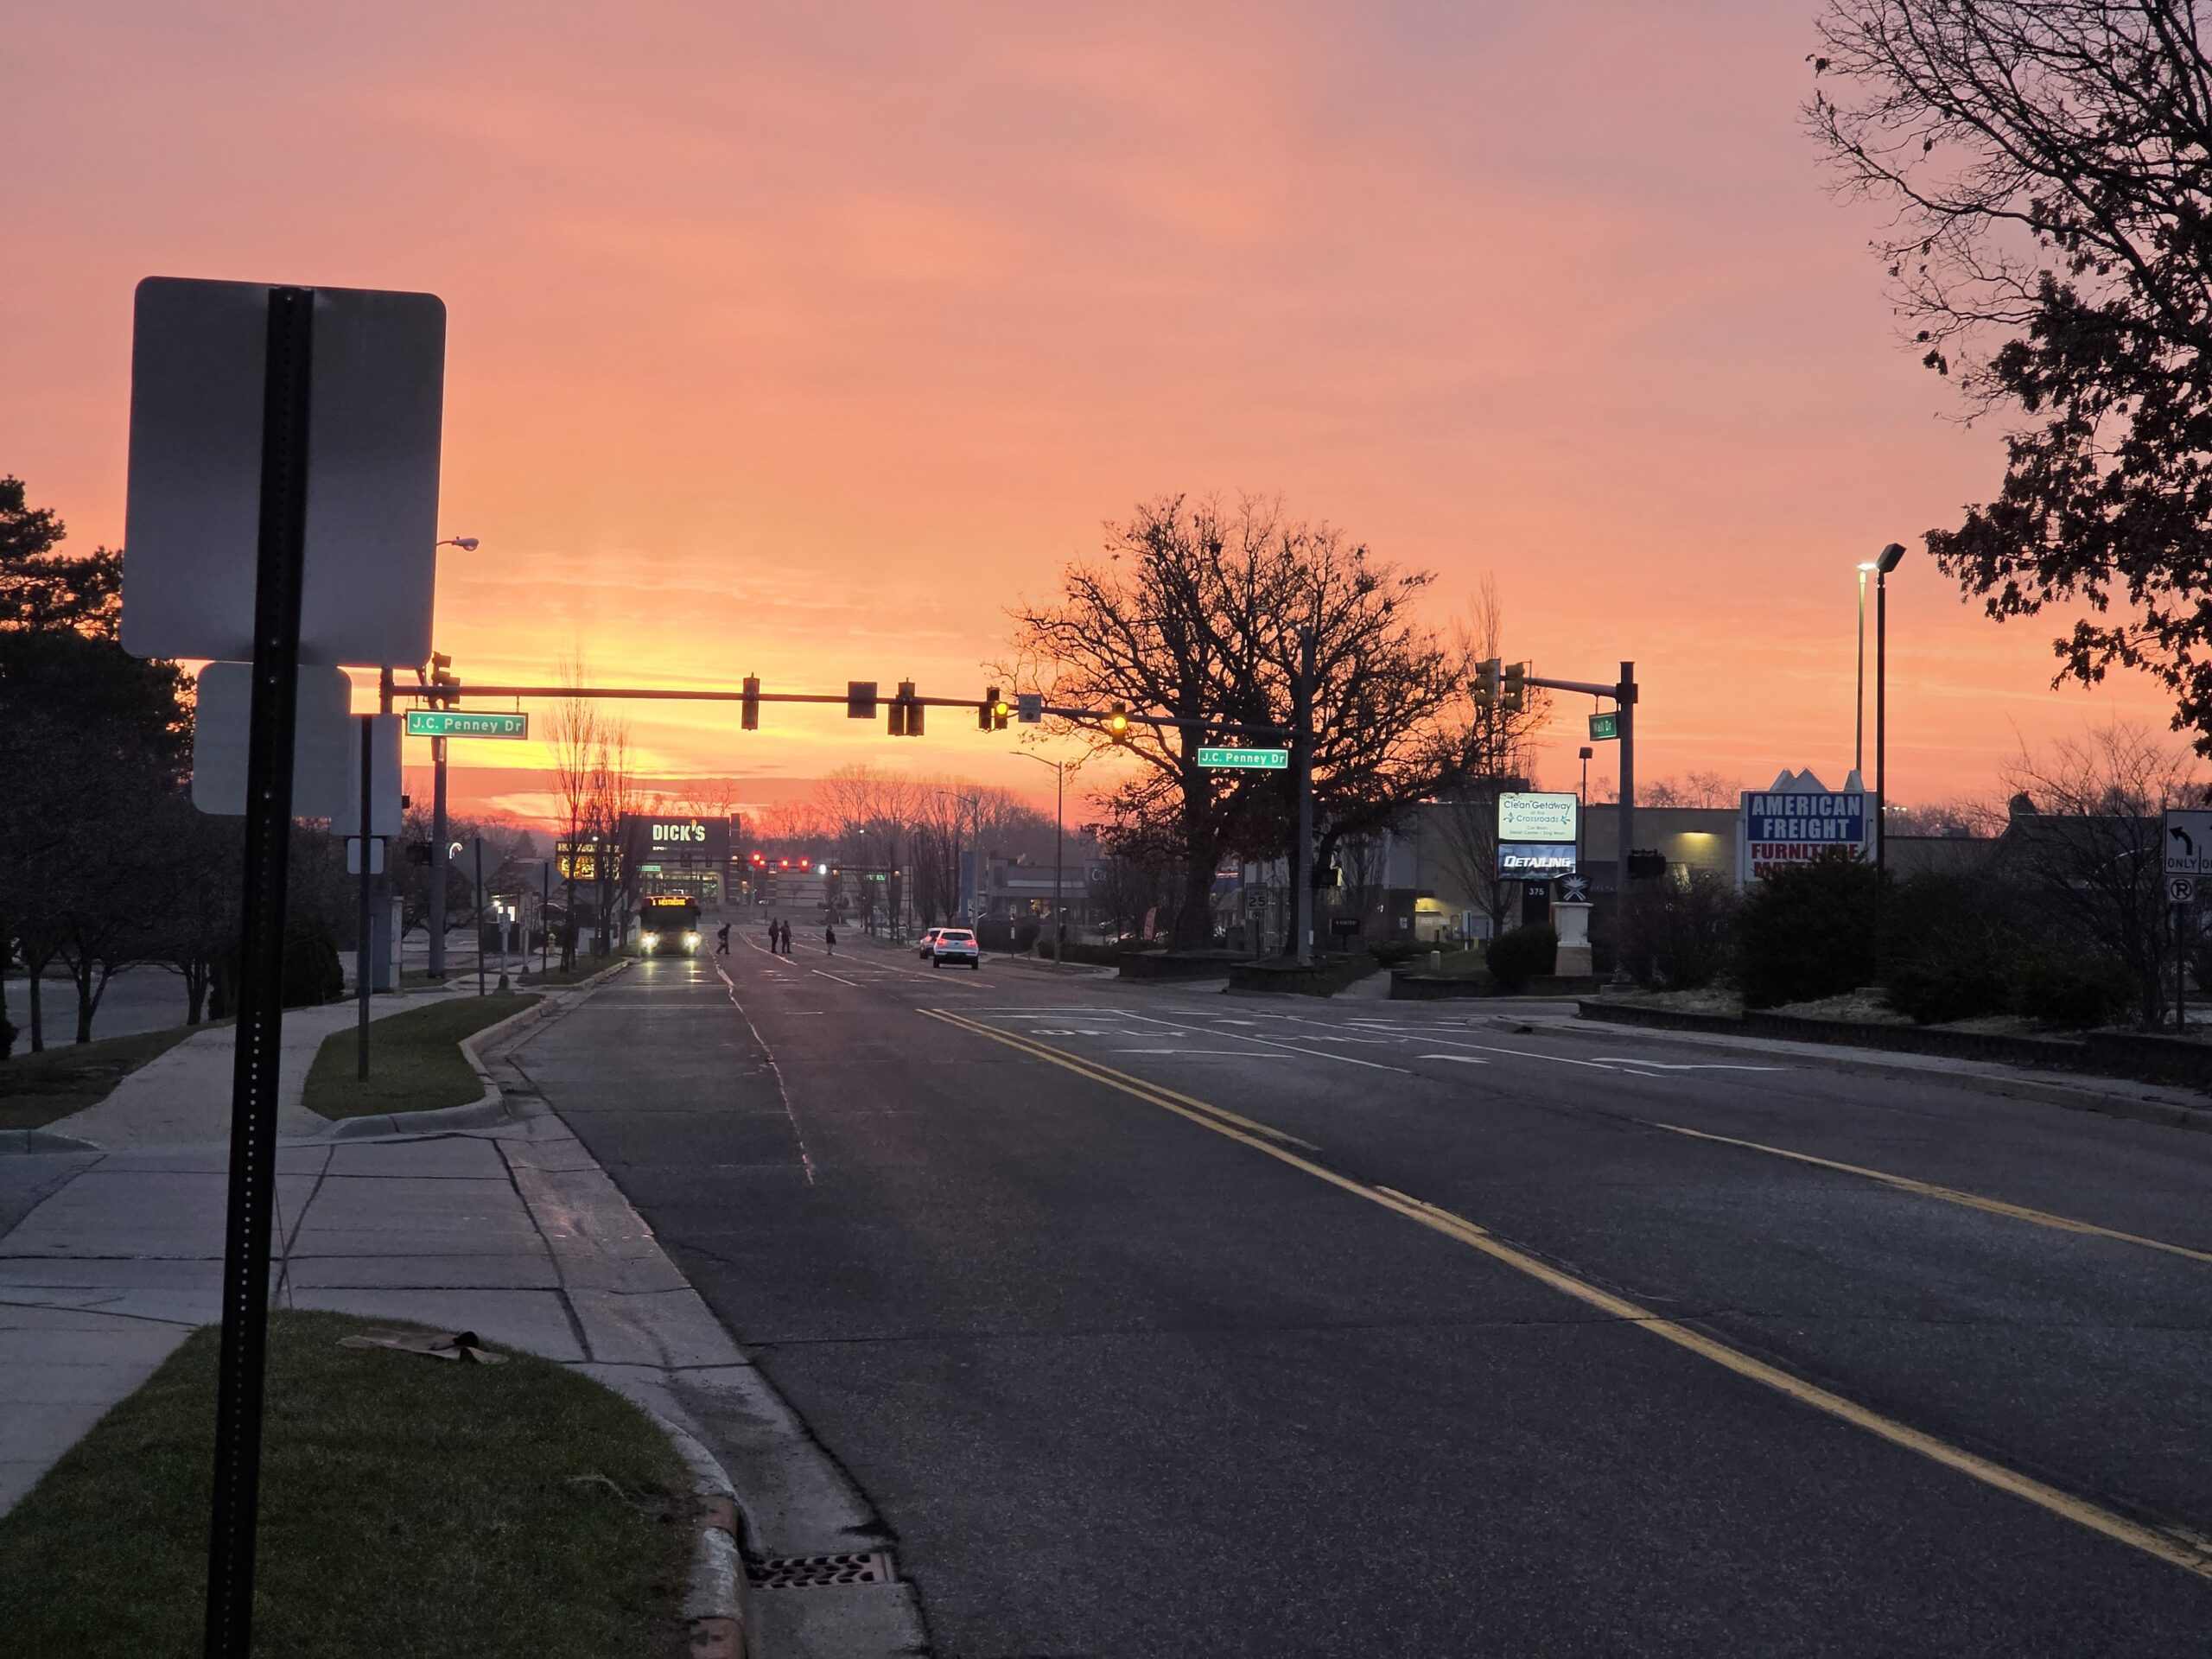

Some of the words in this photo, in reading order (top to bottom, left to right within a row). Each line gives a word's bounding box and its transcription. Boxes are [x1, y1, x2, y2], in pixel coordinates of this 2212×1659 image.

[412, 717, 439, 729] J.C.
[444, 718, 498, 734] Penney
[505, 720, 522, 732] Dr
[1202, 753, 1223, 762] J.C.
[1225, 753, 1268, 766] Penney
[1271, 753, 1285, 764] Dr
[1503, 800, 1531, 809] Clean
[1532, 801, 1571, 814] Getaway
[1751, 795, 1860, 817] AMERICAN
[652, 823, 706, 842] DICK'S
[1763, 818, 1850, 839] FREIGHT
[1751, 843, 1859, 859] FURNITE
[2168, 857, 2196, 868] ONLY
[1249, 897, 1266, 906] 25
